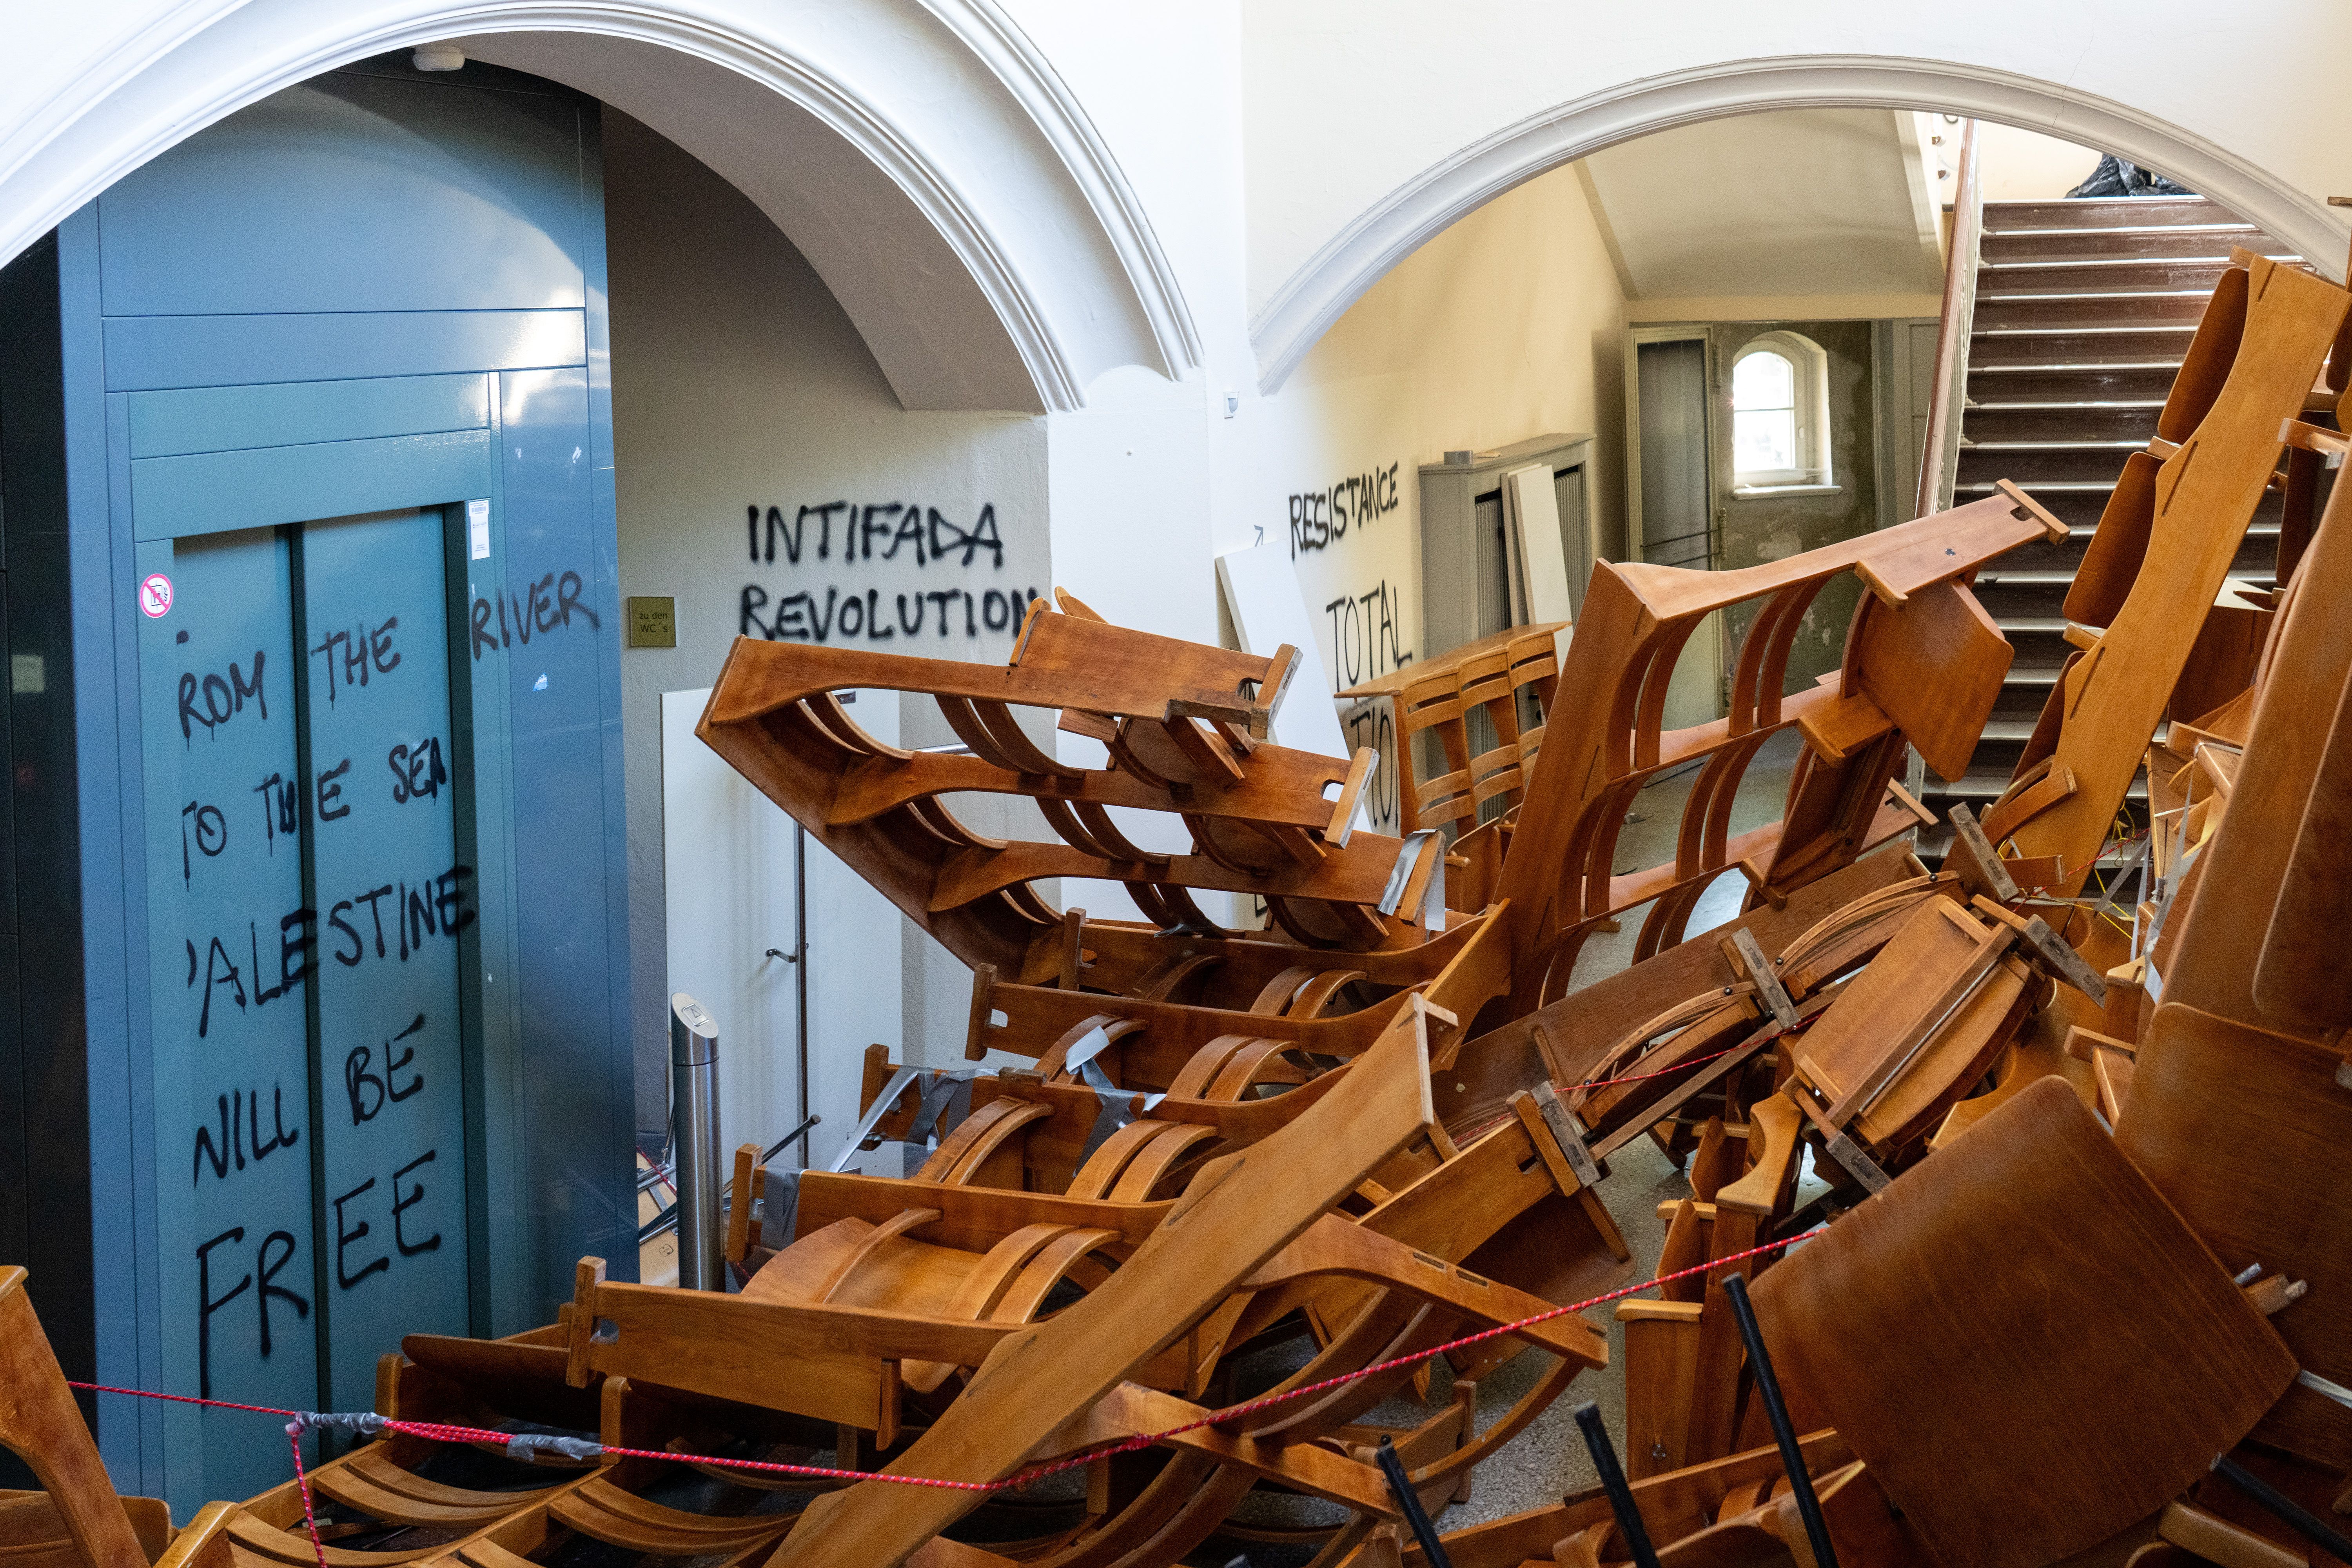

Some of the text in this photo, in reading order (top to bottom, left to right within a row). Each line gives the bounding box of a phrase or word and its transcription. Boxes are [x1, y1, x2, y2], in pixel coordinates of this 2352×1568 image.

[747, 500, 1004, 569] INTIFADA
[1289, 460, 1399, 561] RESISTANCE
[176, 570, 601, 747] ROM THE RIVER
[652, 611, 668, 619] den
[739, 584, 1040, 643] REVOLUTION
[1326, 579, 1413, 693] TOTAL
[388, 736, 448, 806] SEA
[345, 1014, 425, 1127] BE
[196, 1149, 442, 1407] FREE
